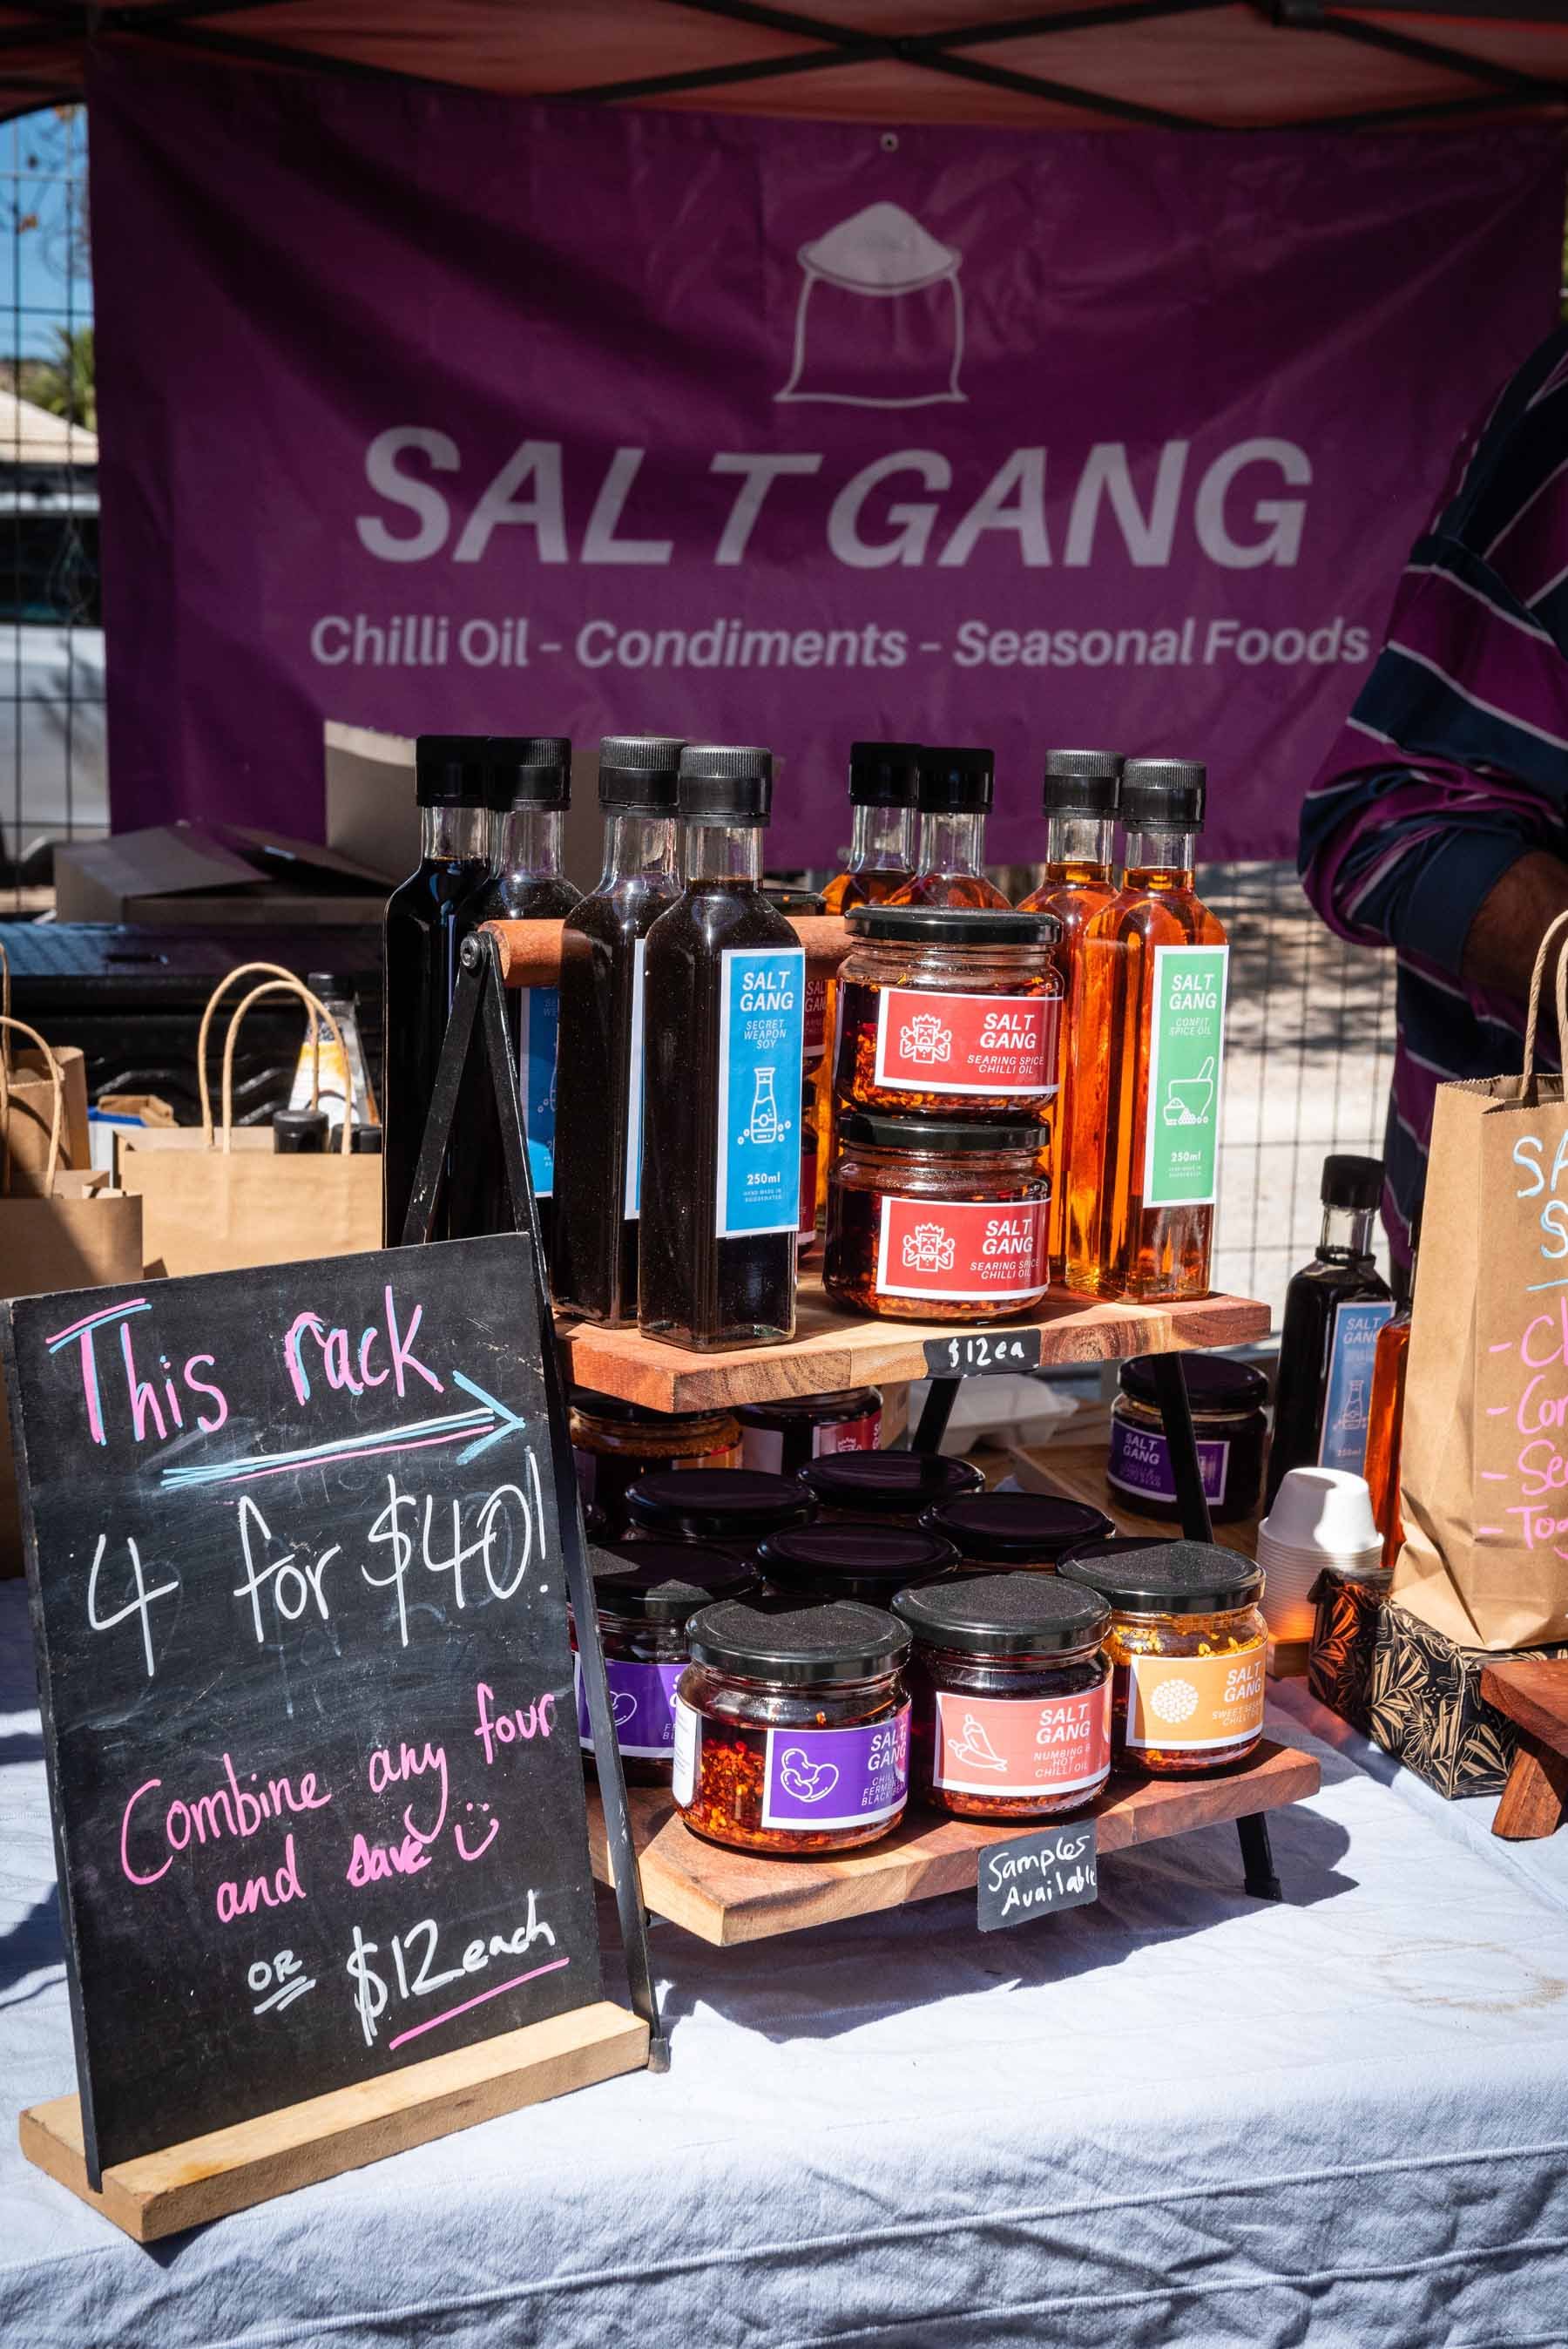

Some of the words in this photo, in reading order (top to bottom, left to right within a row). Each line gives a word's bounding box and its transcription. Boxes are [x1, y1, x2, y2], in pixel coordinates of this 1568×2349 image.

[355, 425, 824, 566] SALT
[827, 437, 1314, 569] GANG
[310, 614, 449, 667] Chilli
[458, 617, 529, 667] Oil
[575, 618, 908, 667] Condiments
[953, 616, 1193, 667] Seasonal
[1202, 616, 1369, 666] Foods
[741, 971, 791, 991] SALT
[806, 980, 827, 996] SAL
[1171, 973, 1215, 992] SALT
[740, 992, 794, 1012] GANG
[805, 997, 828, 1013] GAN
[1169, 992, 1217, 1011] GANG
[746, 1019, 786, 1031] SECRET
[983, 1012, 1036, 1032] SALT
[743, 1029, 787, 1040] WEAPON
[979, 1031, 1037, 1050] GANG
[756, 1039, 778, 1050] SOY
[967, 1054, 1017, 1066] SEARING
[1018, 1055, 1045, 1066] SPICE
[978, 1063, 1016, 1074] CHILLI
[1018, 1065, 1034, 1074] OIL
[1170, 1149, 1202, 1163] 250ml
[746, 1170, 781, 1186] 250ml
[985, 1218, 1032, 1237] SALT
[982, 1235, 1034, 1256] GANG
[970, 1261, 1017, 1271] SEARING
[981, 1269, 1017, 1280] CHILLI
[1345, 1317, 1382, 1331] SALT
[45, 1297, 229, 1446] This
[283, 1284, 445, 1405] rack
[1124, 1432, 1159, 1452] SALT
[1121, 1444, 1161, 1466] GANG
[88, 1533, 179, 1677] 4
[233, 1494, 342, 1643] for
[362, 1452, 550, 1647] $40!
[1226, 1660, 1262, 1686] SALT
[1224, 1677, 1261, 1703] GANG
[1038, 1703, 1089, 1726] SALT
[1035, 1720, 1092, 1745] GANG
[868, 1741, 907, 1771] GANG
[1032, 1745, 1083, 1762] NUMBING
[1052, 1756, 1074, 1768] HOT
[1034, 1765, 1072, 1778] CHILLI
[120, 1751, 333, 1886] Combine
[368, 1742, 449, 1845] any
[473, 1682, 554, 1765] four
[216, 1832, 307, 1923] and
[346, 1832, 433, 1888] save
